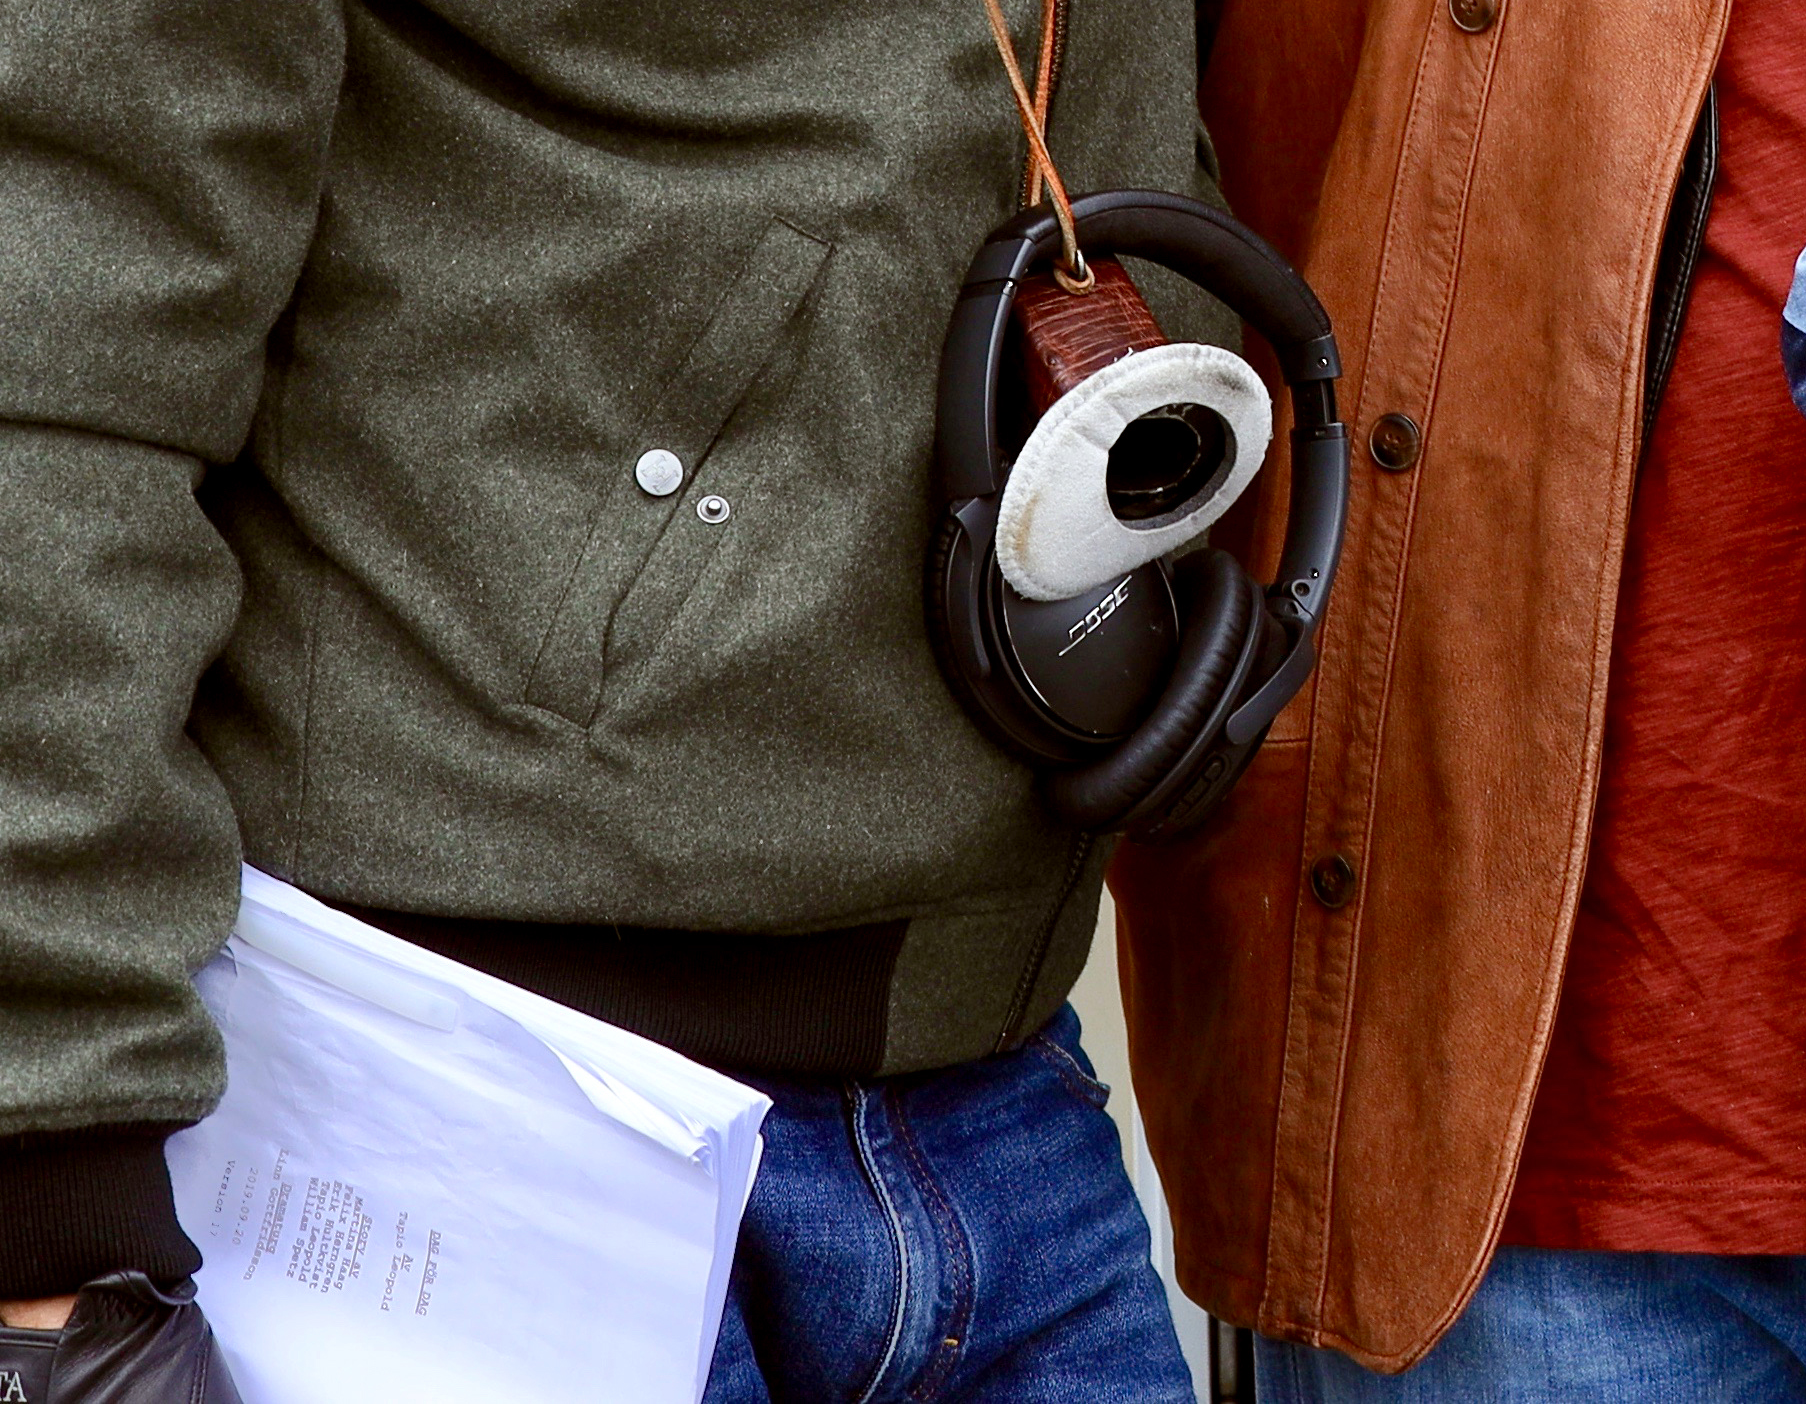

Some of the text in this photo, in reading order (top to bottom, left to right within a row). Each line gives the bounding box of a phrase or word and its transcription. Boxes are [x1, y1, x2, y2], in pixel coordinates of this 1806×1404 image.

[215, 1160, 235, 1213] Version
[273, 1148, 289, 1180] Linn
[329, 1180, 342, 1212] Erik
[298, 1181, 330, 1282] Tapio Leopold
[321, 1185, 354, 1293] Felix Herngren
[334, 1196, 363, 1290] Martina Haag
[359, 1215, 373, 1256] Story
[430, 1230, 442, 1255] DAG
[380, 1212, 408, 1311] Tapio Leopold
[418, 1291, 431, 1316] DAG
